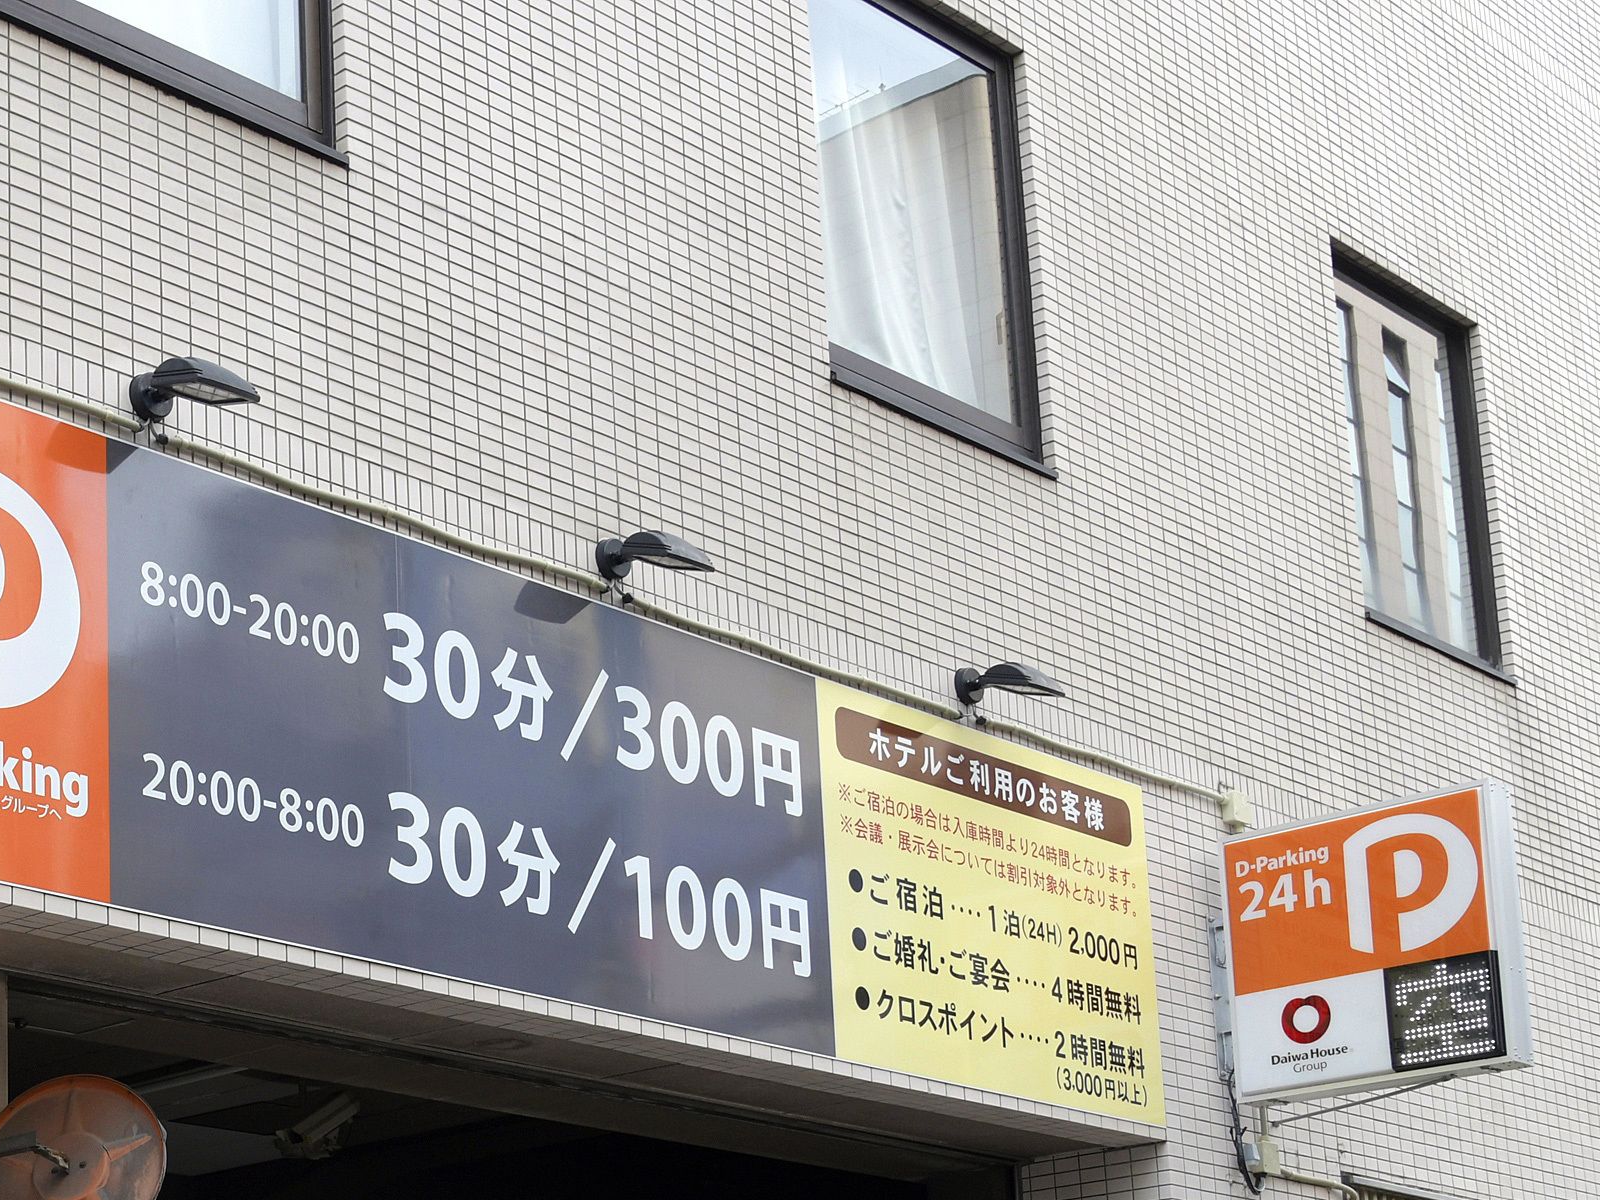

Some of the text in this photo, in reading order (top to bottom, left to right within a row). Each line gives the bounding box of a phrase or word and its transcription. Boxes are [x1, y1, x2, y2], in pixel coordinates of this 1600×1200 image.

[140, 561, 360, 665] 8:00-20:00
[142, 752, 365, 847] 20:00-8:00
[868, 727, 1106, 832] ホテルご利用のお客様
[1235, 846, 1329, 878] D-Parking
[1239, 868, 1332, 922] 24h
[1271, 1045, 1349, 1066] Daiwa House
[1293, 1060, 1328, 1074] Group
[1056, 1068, 1148, 1108] (3,000円以上)
